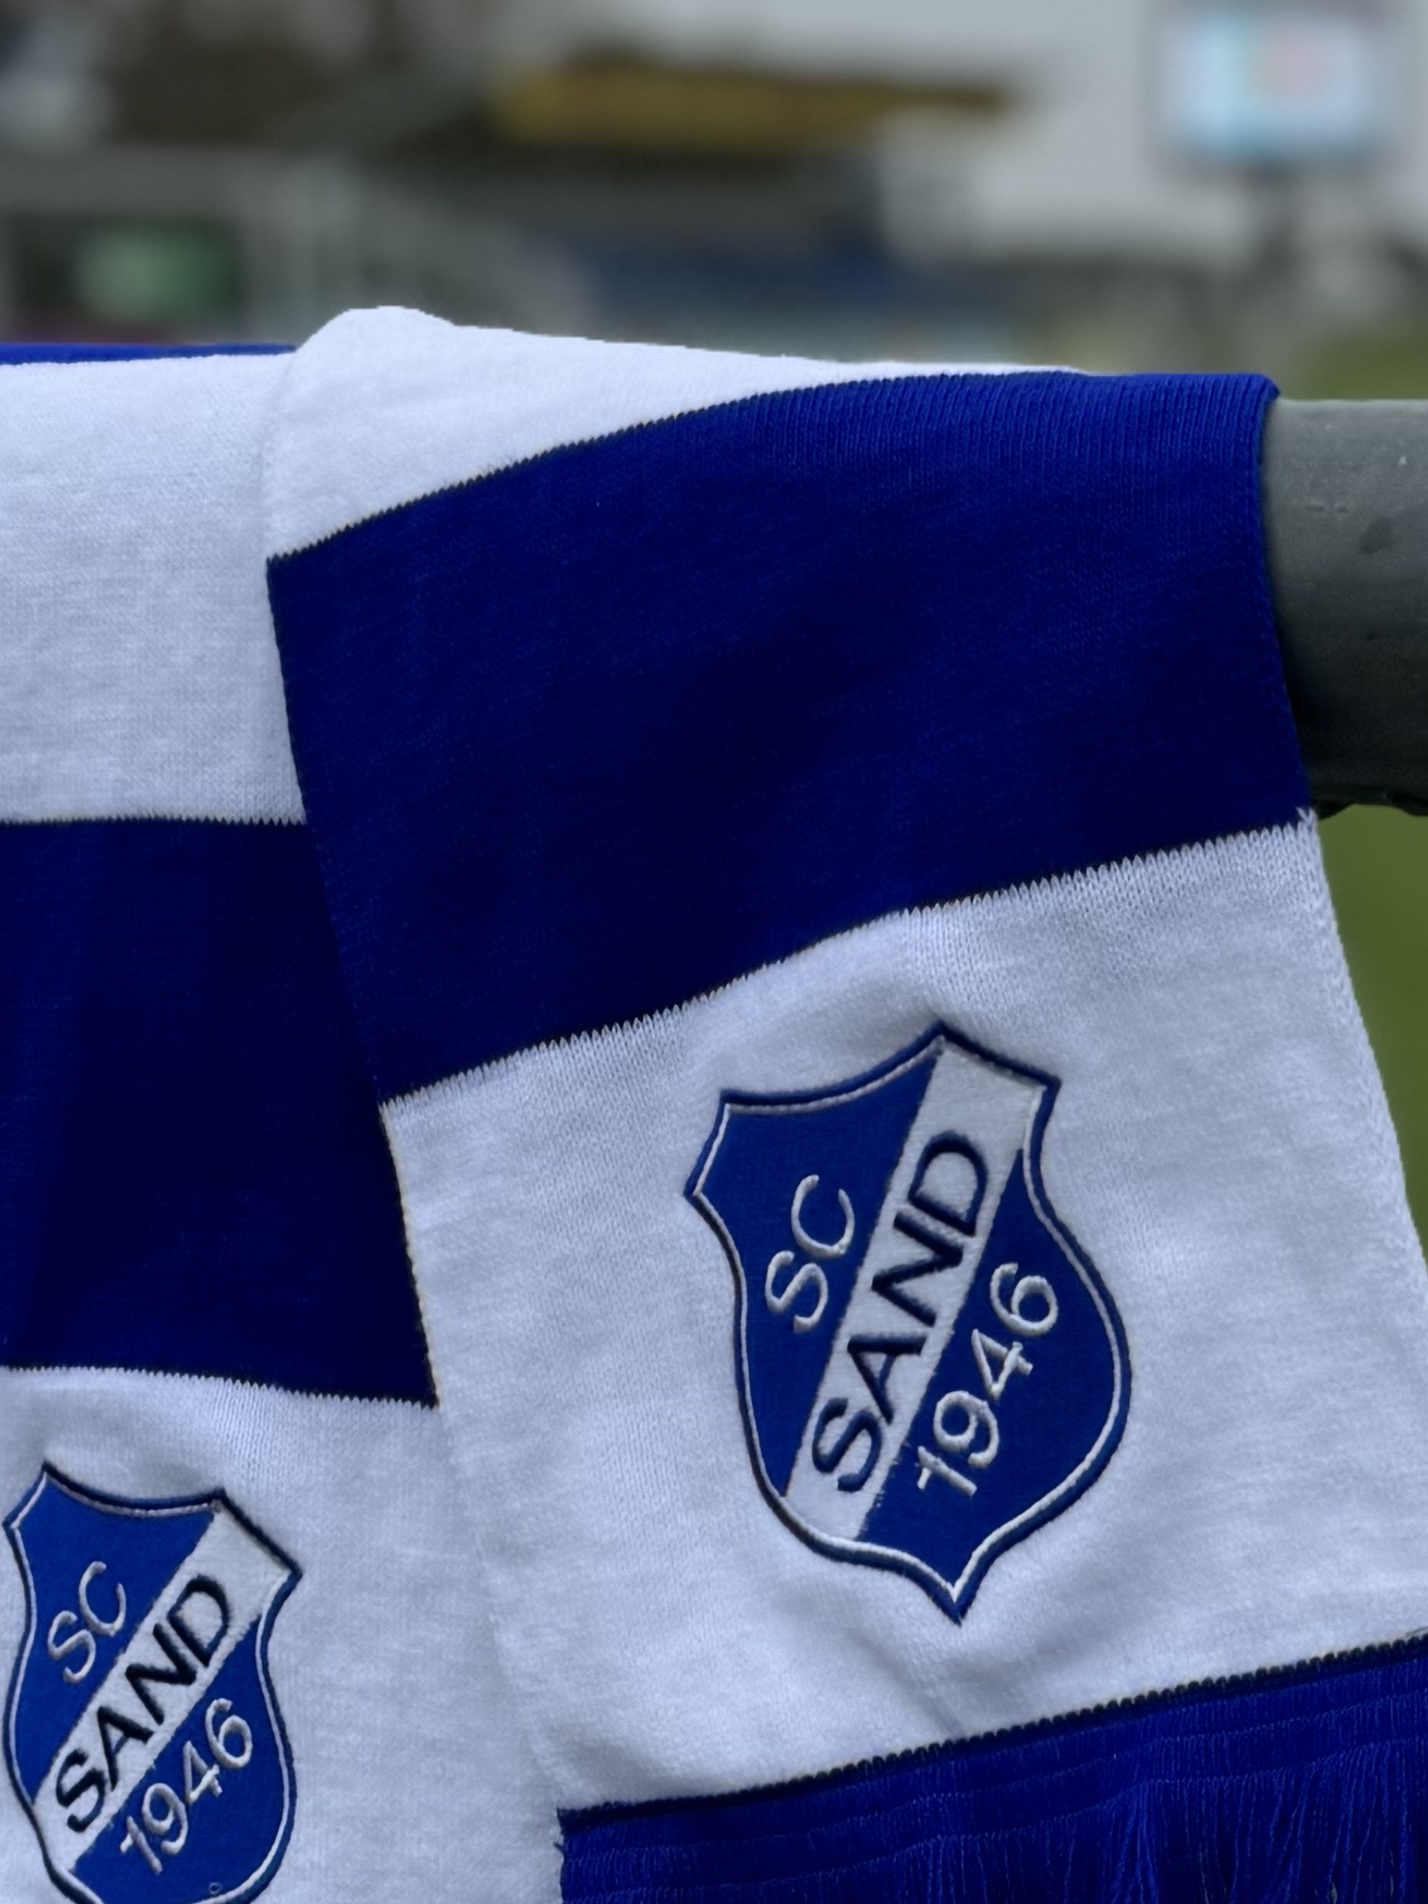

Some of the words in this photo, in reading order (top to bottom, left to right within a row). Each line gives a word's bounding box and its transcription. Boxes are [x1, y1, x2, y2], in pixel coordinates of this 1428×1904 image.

[765, 1174, 855, 1333] SC
[811, 1130, 988, 1493] SAND
[916, 1263, 1059, 1495] 1946
[47, 1560, 128, 1684] SC
[54, 1574, 231, 1834] SAND
[119, 1698, 253, 1875] 1946
